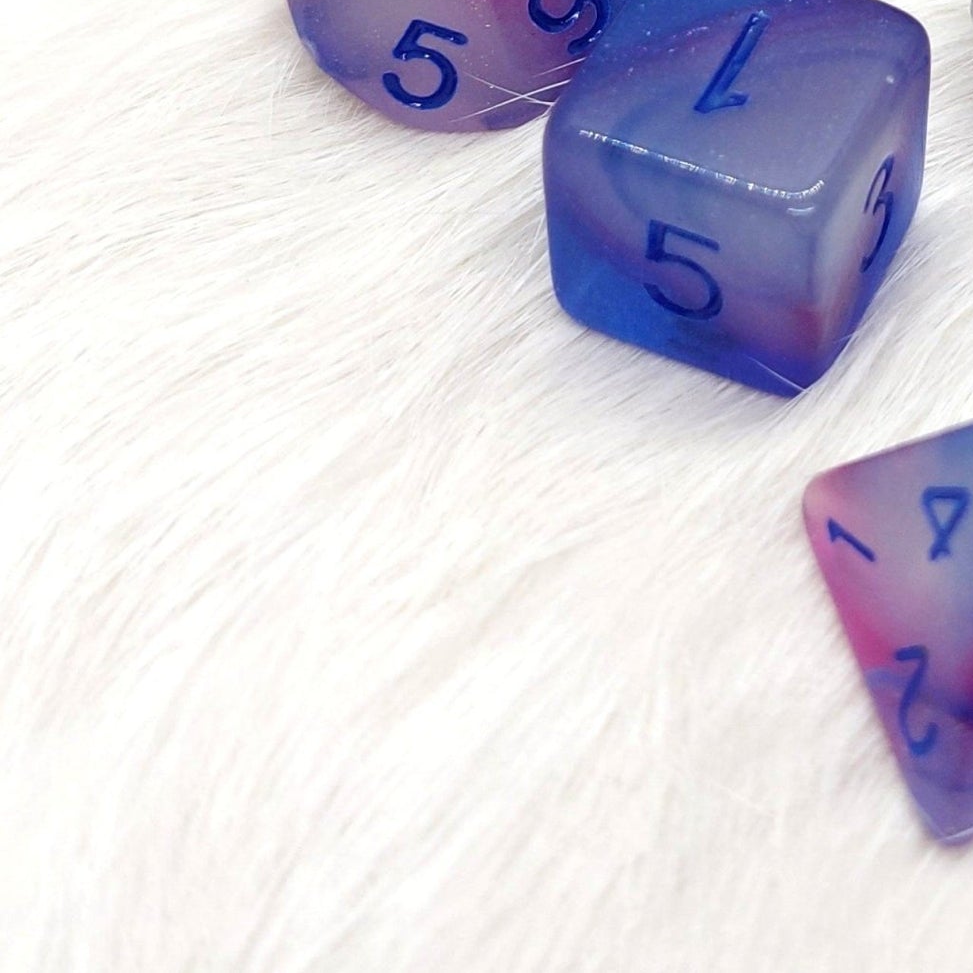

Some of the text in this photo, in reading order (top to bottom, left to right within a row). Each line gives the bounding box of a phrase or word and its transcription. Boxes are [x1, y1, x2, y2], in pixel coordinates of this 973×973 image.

[382, 19, 469, 110] 5
[694, 10, 771, 114] 1
[859, 152, 896, 273] 3
[643, 219, 724, 321] 5
[827, 517, 877, 563] 1
[921, 486, 971, 562] 4
[893, 644, 938, 756] 2
